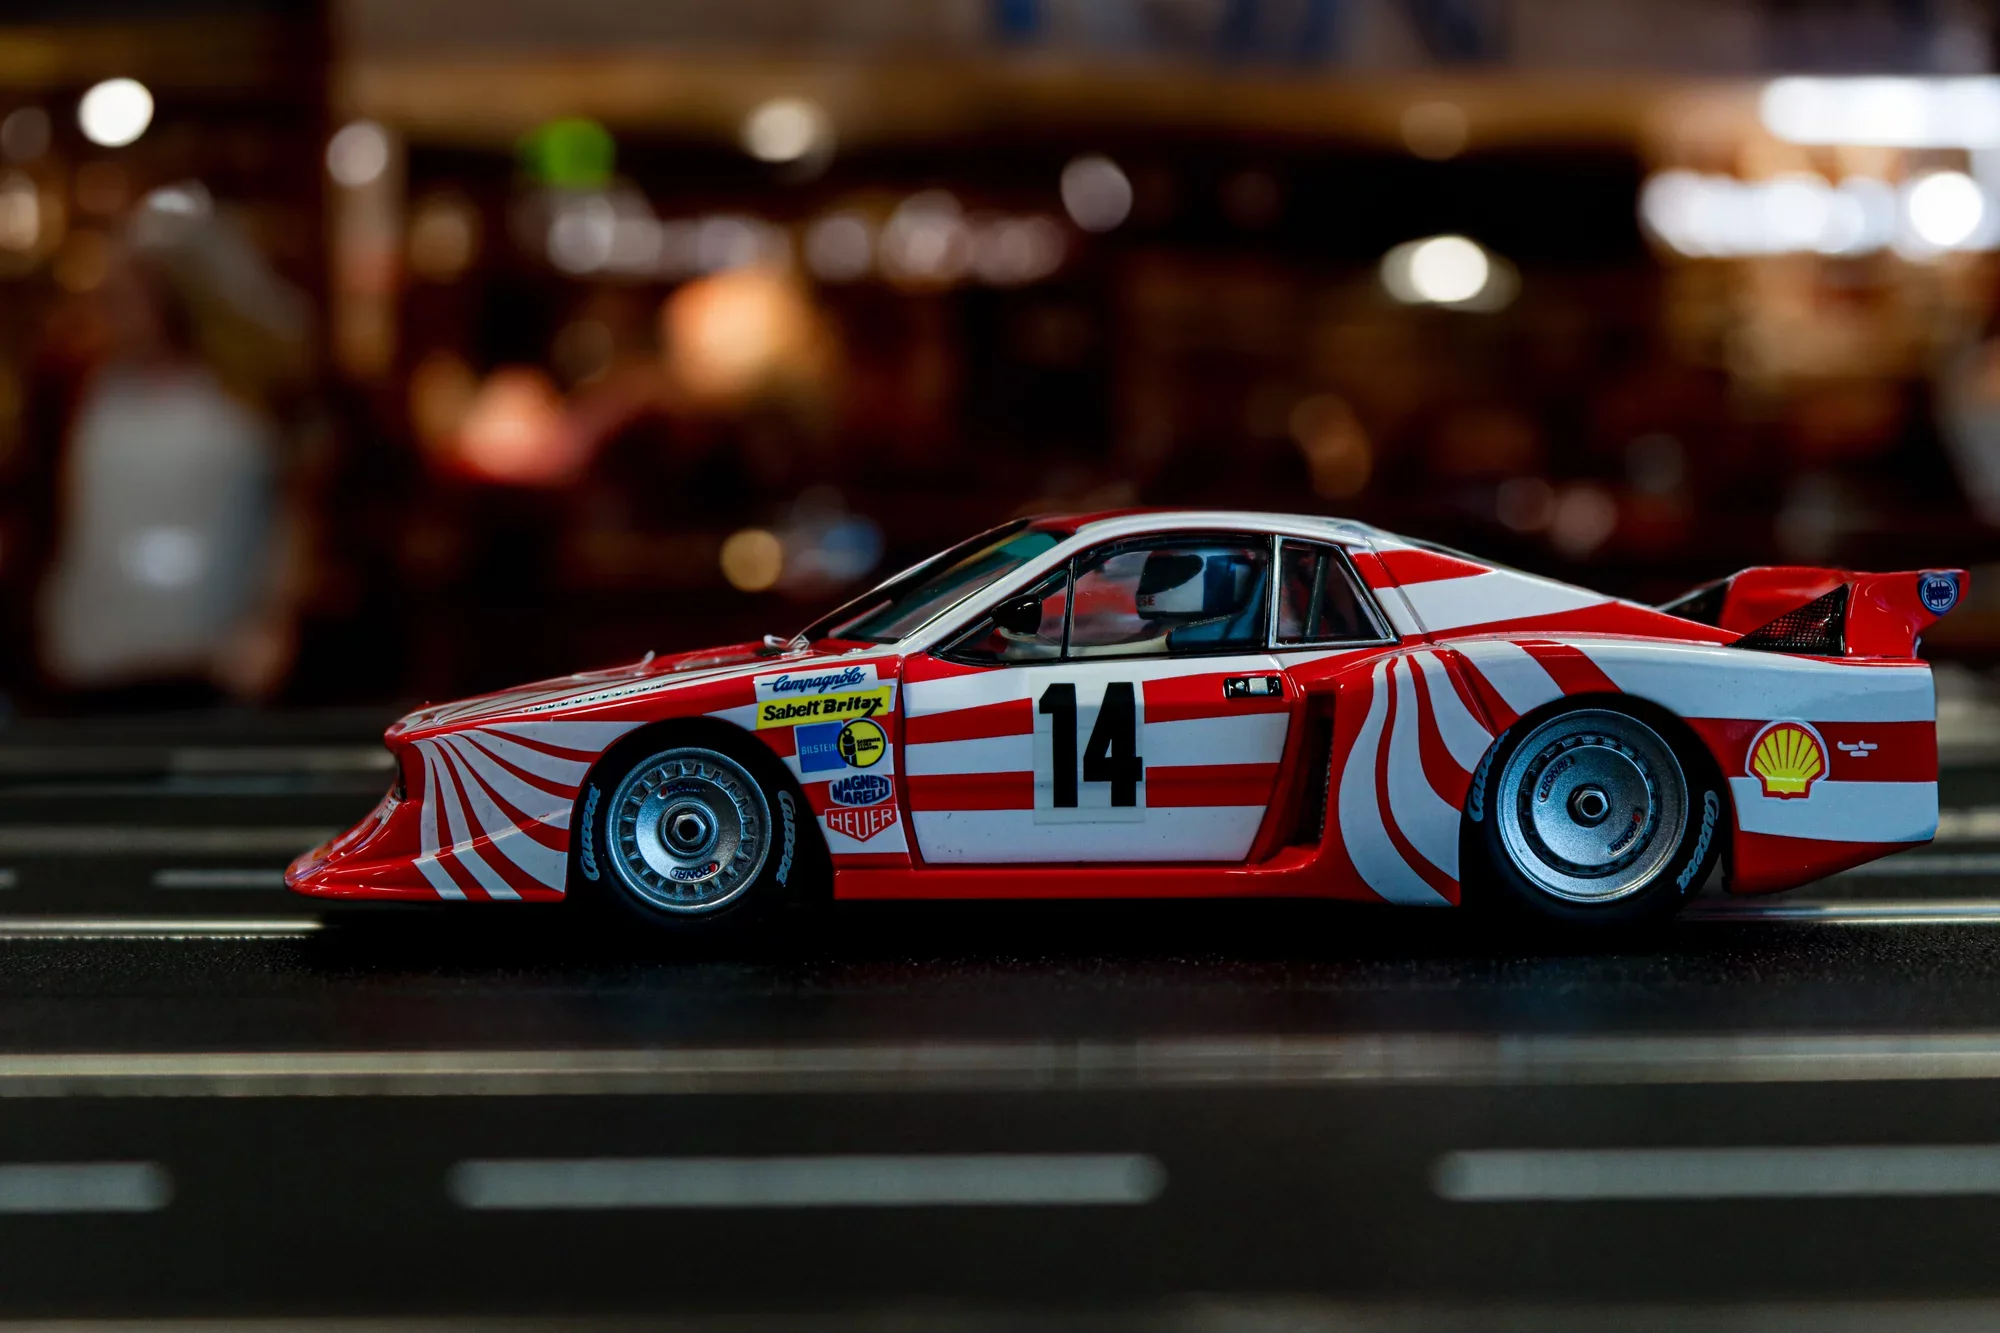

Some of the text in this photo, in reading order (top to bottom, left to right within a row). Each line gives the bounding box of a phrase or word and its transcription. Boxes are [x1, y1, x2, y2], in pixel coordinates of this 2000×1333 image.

[761, 667, 866, 694] Campagnolo
[763, 696, 883, 721] Sabelt Britax
[801, 743, 837, 755] BILSTEIN
[1039, 682, 1143, 808] 14
[580, 782, 600, 881] Carrera
[776, 790, 796, 887] Carrera
[830, 809, 893, 839] HEUER
[1676, 790, 1719, 894] Carrera
